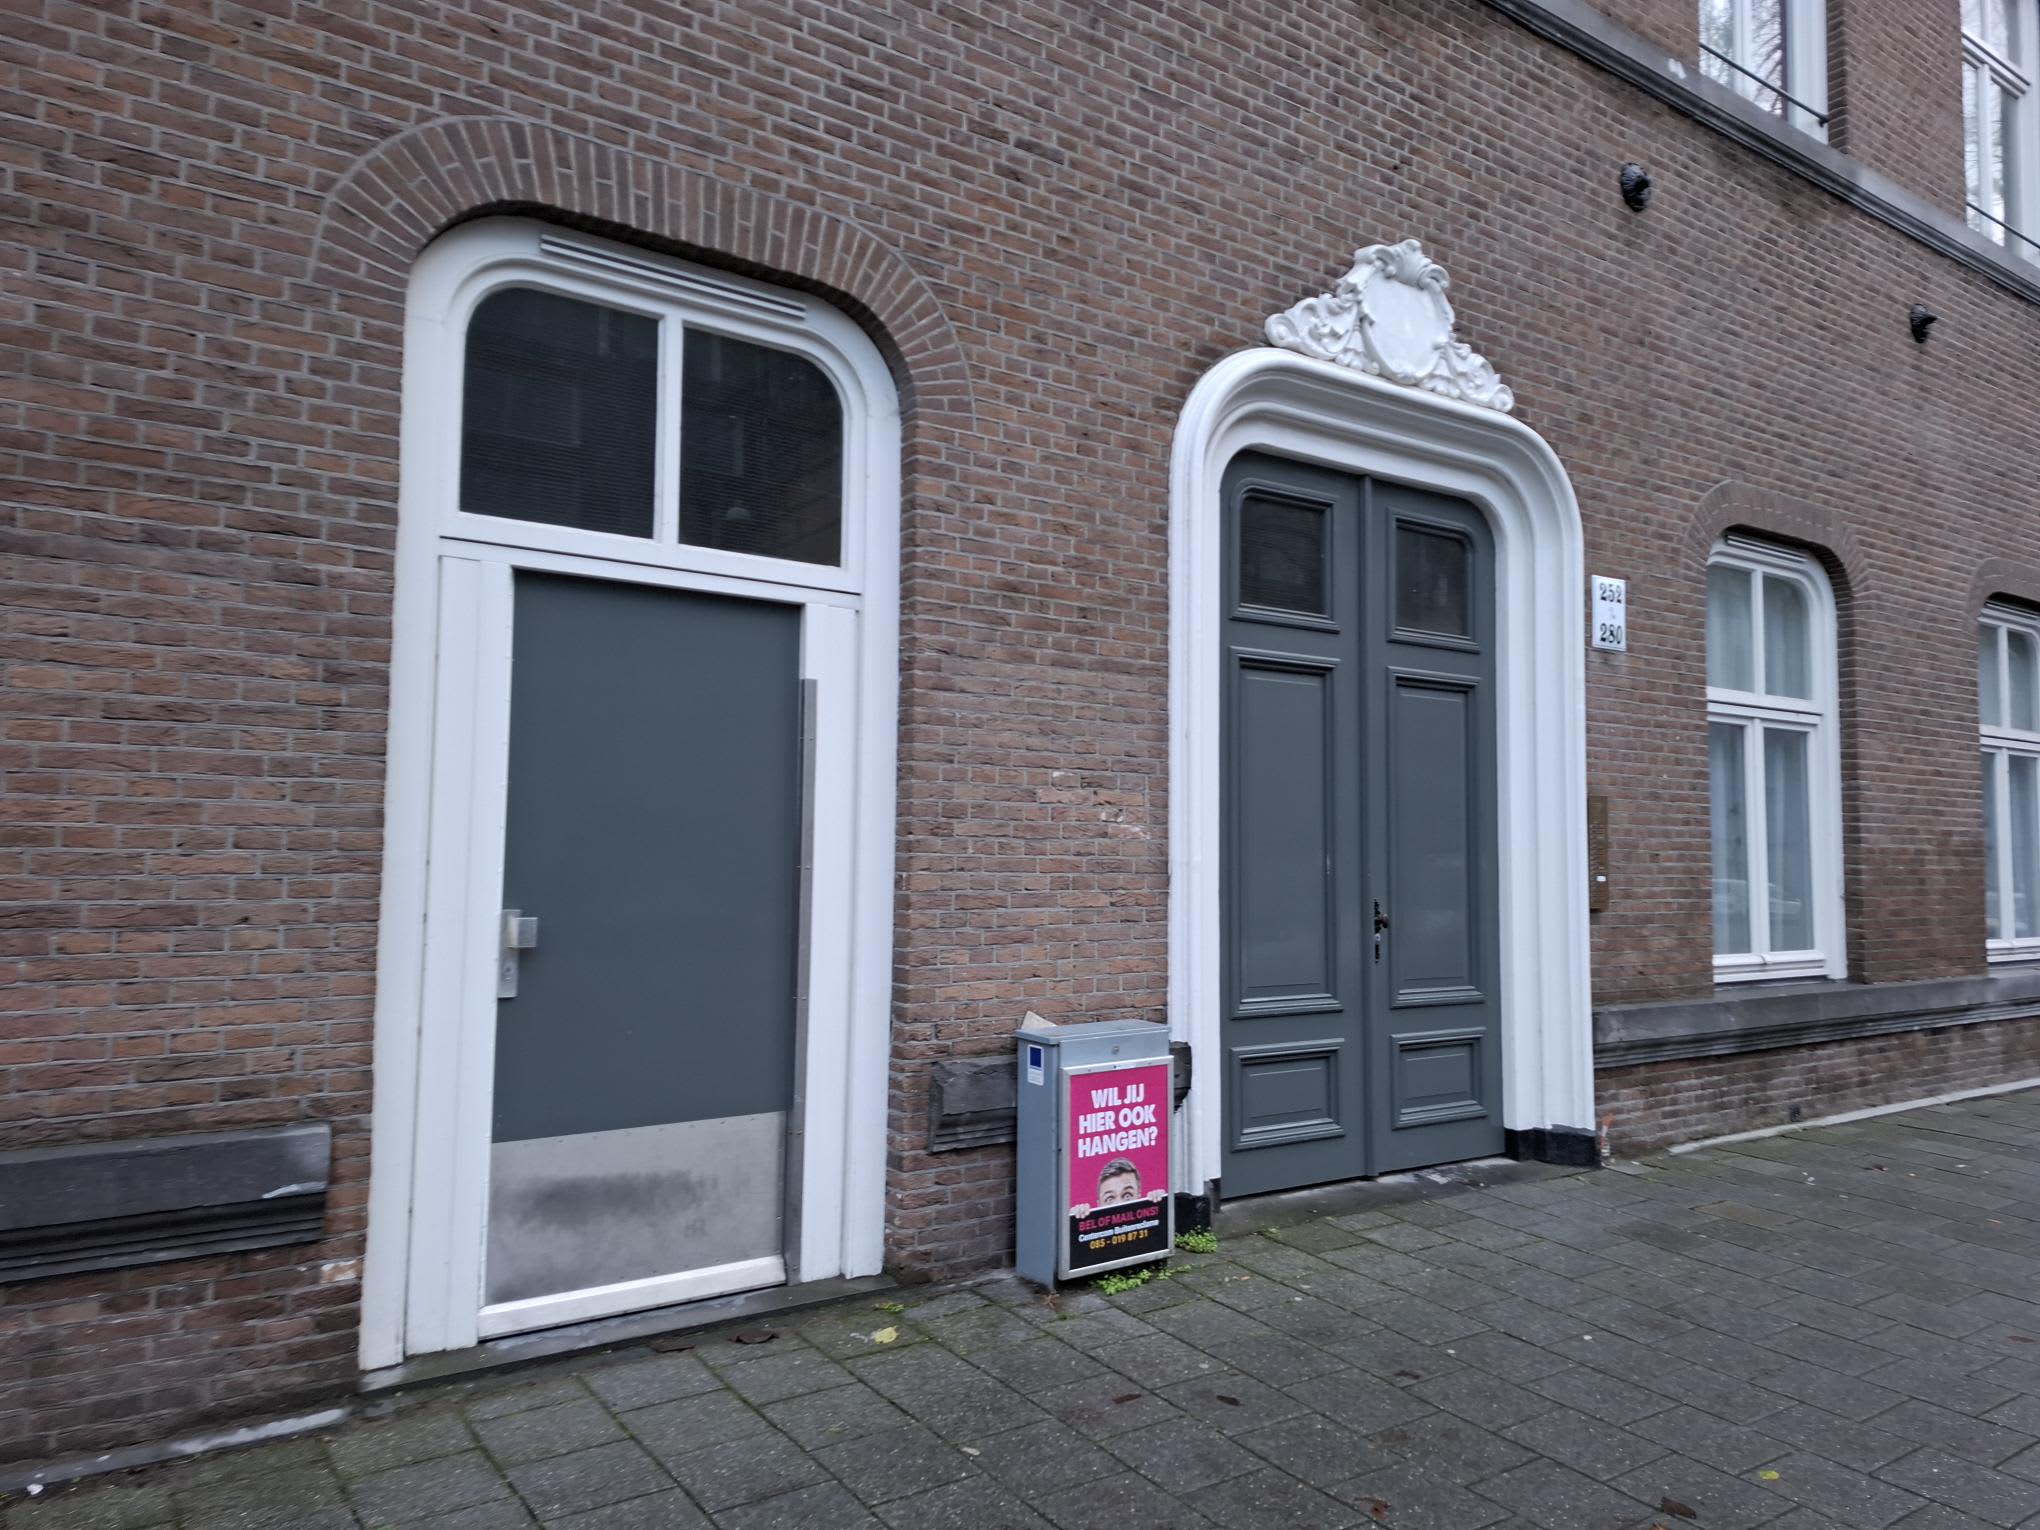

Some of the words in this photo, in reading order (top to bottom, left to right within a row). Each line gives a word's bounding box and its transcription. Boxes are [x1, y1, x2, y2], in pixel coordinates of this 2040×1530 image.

[1600, 582, 1622, 604] 252
[1600, 623, 1623, 645] 280
[1091, 1087, 1122, 1109] WIL
[1123, 1083, 1145, 1105] JIJ
[1078, 1110, 1116, 1134] HIER
[1118, 1104, 1157, 1128] OOK
[1077, 1126, 1158, 1158] HANGEN?
[1078, 1219, 1098, 1231] BEL
[1098, 1216, 1111, 1227] OF
[1111, 1211, 1136, 1225] MAIL
